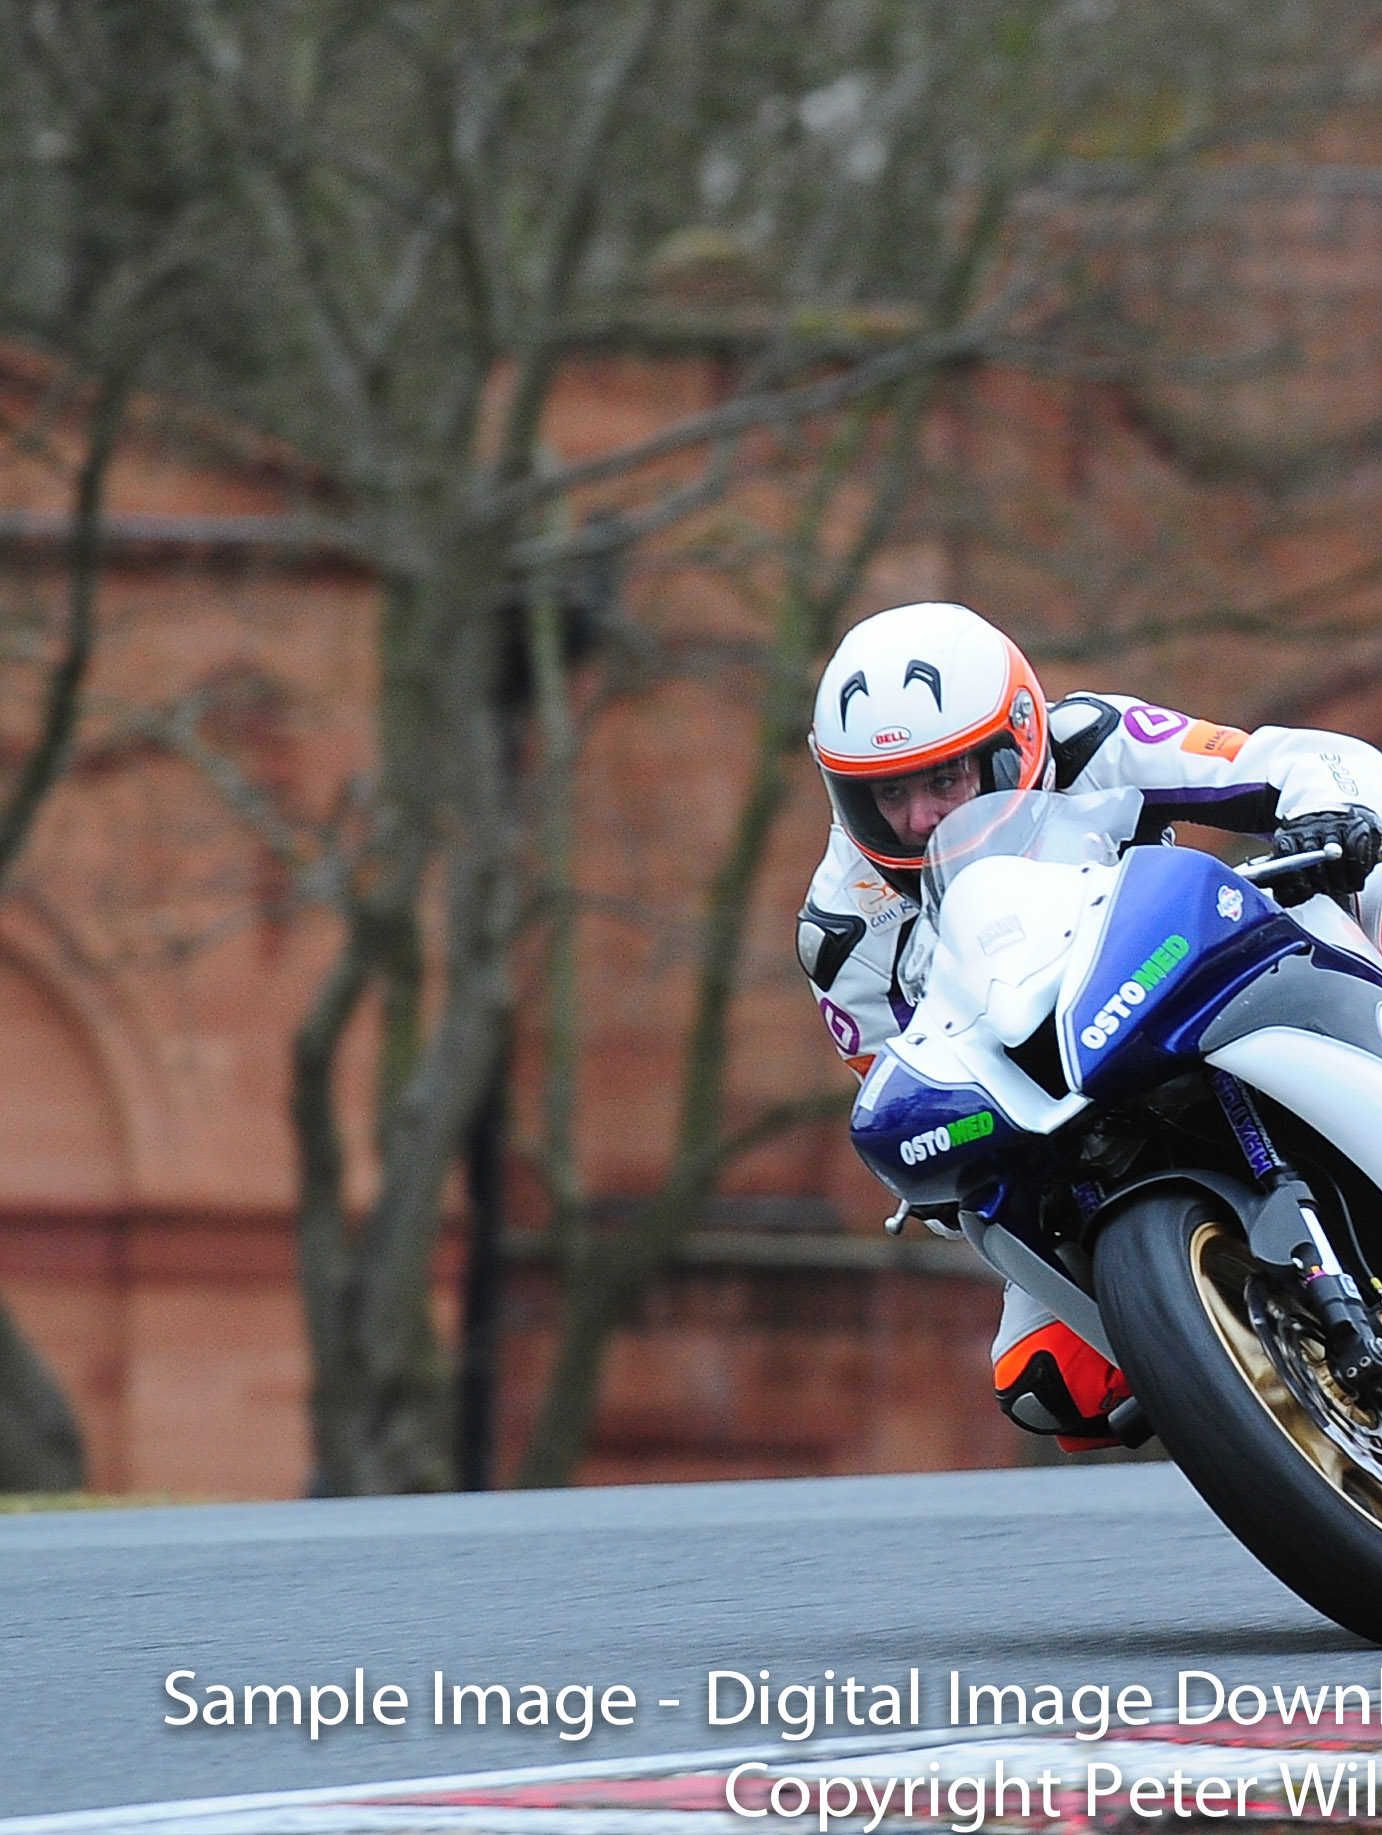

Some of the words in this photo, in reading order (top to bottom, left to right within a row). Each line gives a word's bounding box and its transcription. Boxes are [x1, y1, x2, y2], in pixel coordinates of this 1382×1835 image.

[875, 731, 909, 745] BELL
[1080, 934, 1190, 1050] OSTOMED
[900, 1111, 994, 1166] OSTOMED
